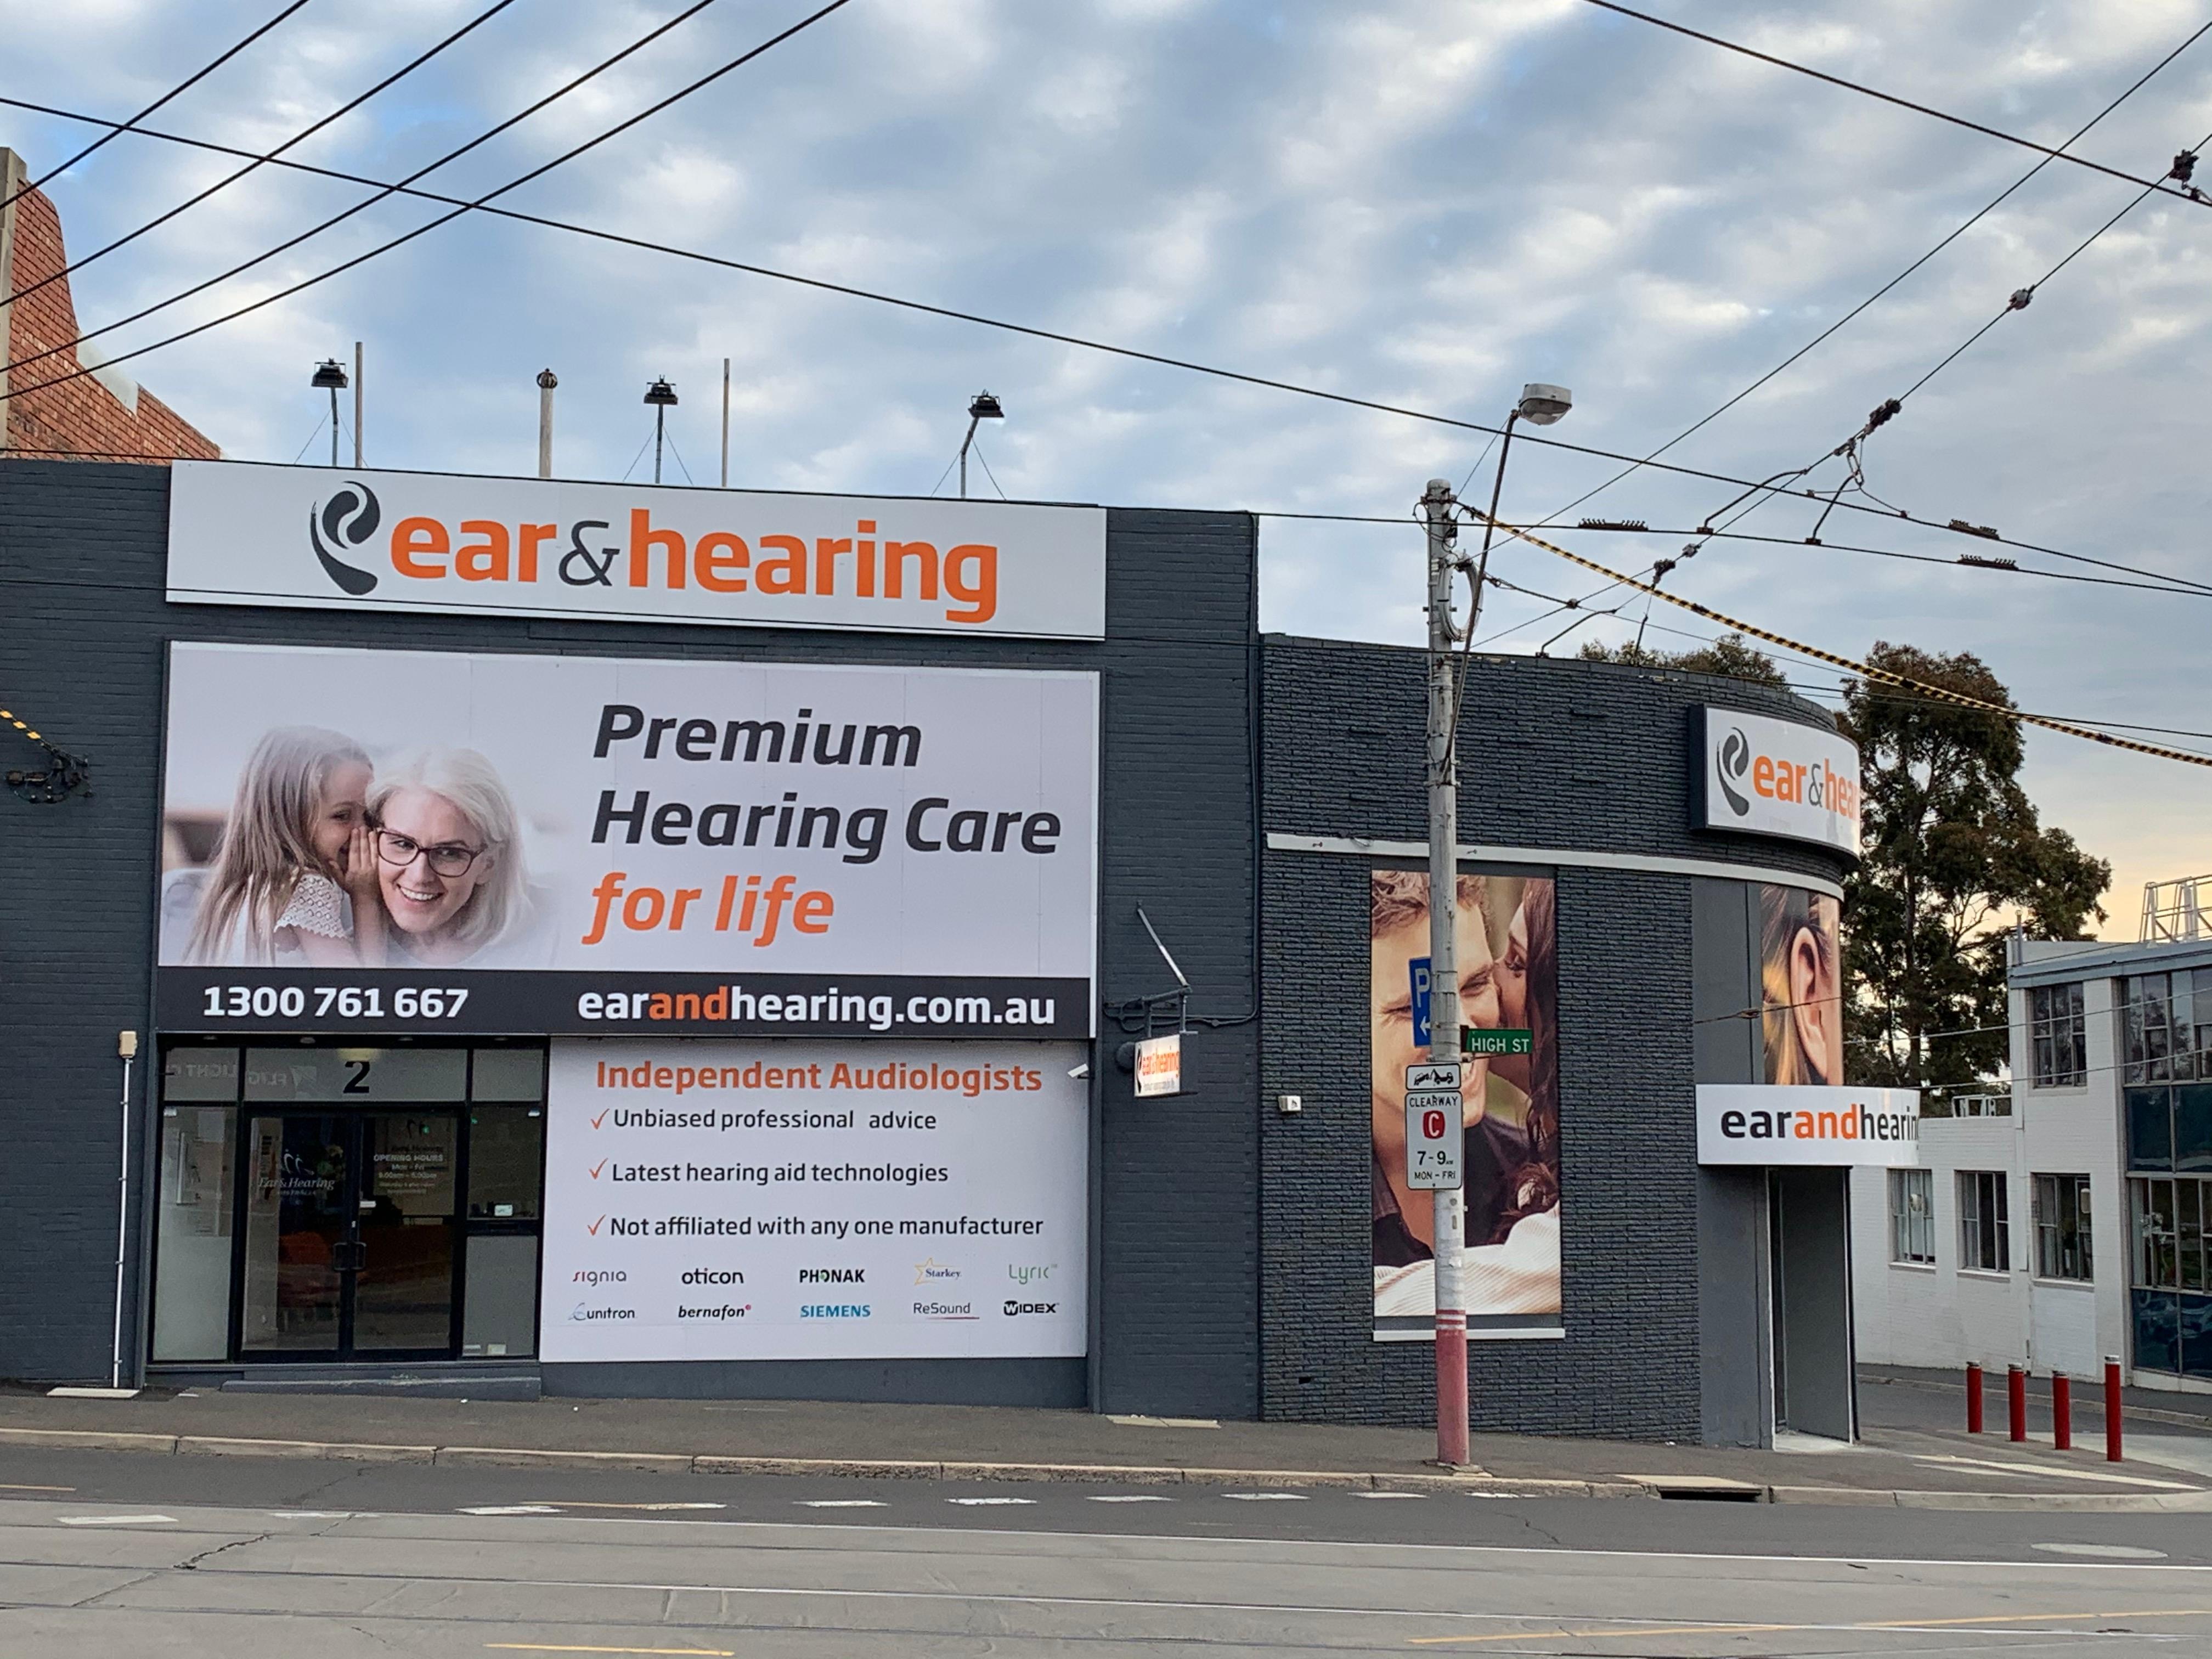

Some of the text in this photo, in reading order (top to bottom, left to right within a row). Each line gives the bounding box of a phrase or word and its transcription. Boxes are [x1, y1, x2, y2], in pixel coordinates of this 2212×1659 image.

[594, 705, 921, 767] Premium
[591, 791, 1061, 864] Hearing Care
[582, 872, 834, 947] for life
[1415, 968, 1430, 1008] P
[204, 986, 469, 1018] 1300 761 667
[578, 986, 1054, 1030] earandhearing.com.au
[1472, 1037, 1530, 1053] HIGH ST
[343, 1061, 370, 1093] 2
[596, 1062, 1042, 1097] Independent Audiologists
[1409, 1096, 1458, 1108] CLEARWAY
[614, 1109, 936, 1132] Unbiased professional advice
[1429, 1113, 1440, 1137] C
[612, 1163, 949, 1186] Latest hearing aid technologies
[1414, 1171, 1432, 1180] MON
[1442, 1171, 1455, 1179] FRI
[610, 1216, 1044, 1240] Not affiliated with any one manufacturer
[573, 1271, 627, 1287] signia
[681, 1268, 744, 1285] oticon
[799, 1269, 865, 1283] PHONAK
[926, 1268, 961, 1280] Starkey
[587, 1307, 635, 1319] unitron
[678, 1305, 745, 1321] bernafon
[800, 1305, 871, 1318] SIEMENS
[913, 1302, 970, 1314] ReSound
[1003, 1301, 1057, 1315] WIDEX
